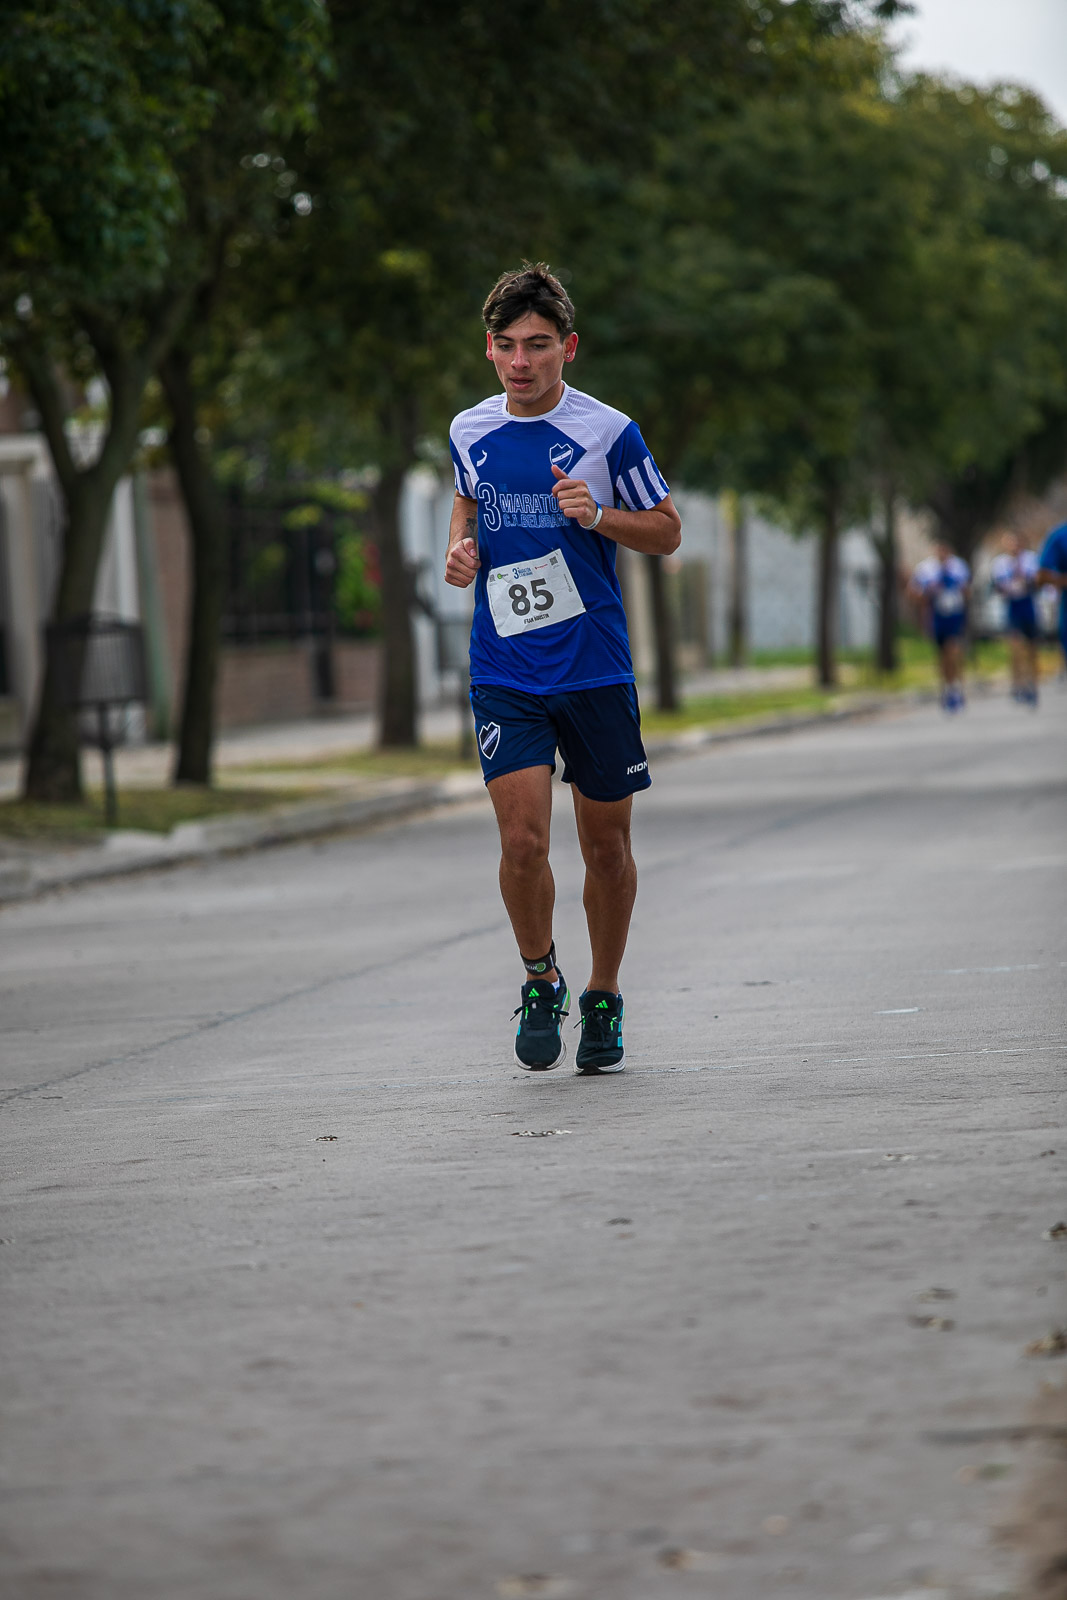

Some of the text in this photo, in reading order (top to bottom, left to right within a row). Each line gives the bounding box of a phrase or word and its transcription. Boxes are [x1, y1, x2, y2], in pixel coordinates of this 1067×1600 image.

[477, 482, 501, 531] 3
[499, 493, 564, 514] MARATÓ
[508, 578, 554, 616] 85
